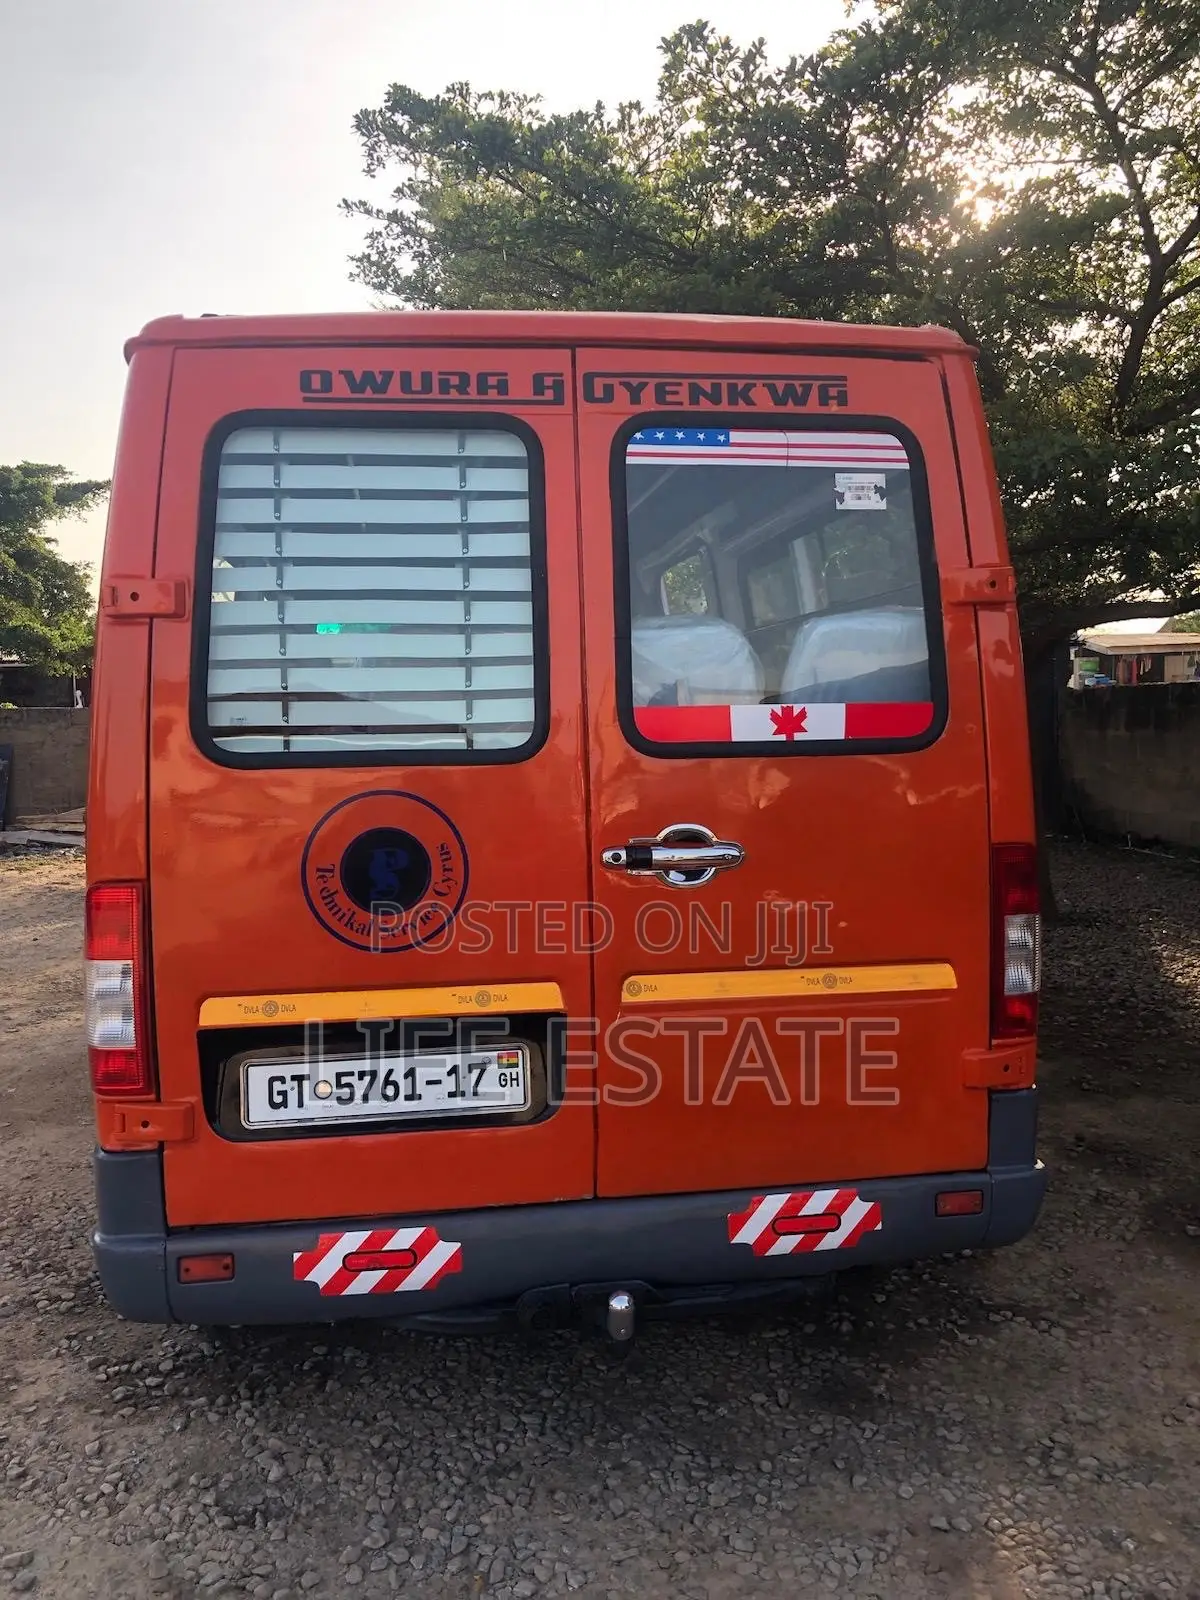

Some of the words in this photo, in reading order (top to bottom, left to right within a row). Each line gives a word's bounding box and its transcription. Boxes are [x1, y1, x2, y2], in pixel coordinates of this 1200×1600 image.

[299, 369, 509, 397] OWURA
[433, 842, 458, 897] Cyrus
[267, 1073, 311, 1110] GT
[498, 1070, 520, 1088] GH
